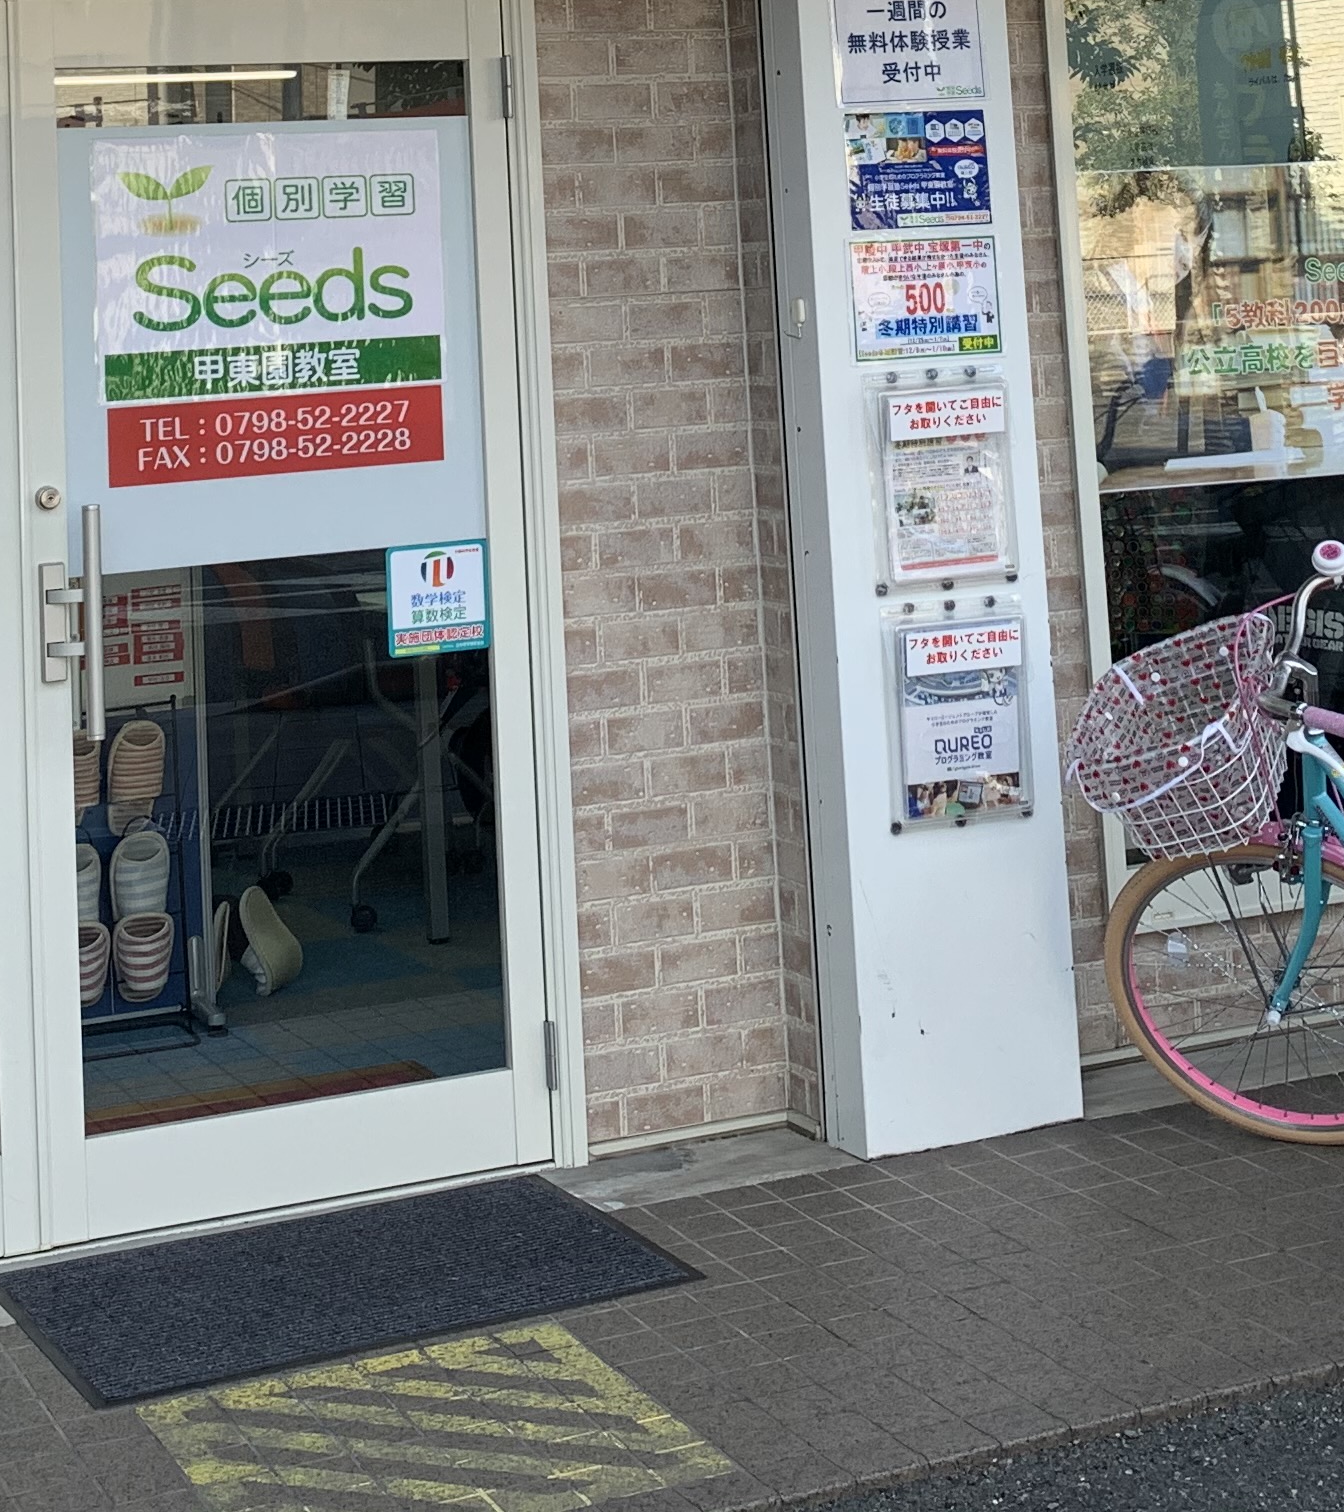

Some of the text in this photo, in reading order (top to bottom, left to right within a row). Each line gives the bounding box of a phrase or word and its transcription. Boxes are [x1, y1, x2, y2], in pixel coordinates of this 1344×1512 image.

[866, 0, 947, 23] 一週間の
[847, 28, 971, 55] 無料体験授業
[882, 61, 942, 85] 受付中
[231, 178, 408, 216] 個別学習
[243, 249, 295, 269] シーズ
[132, 246, 413, 332] Seeds
[905, 281, 947, 316] 500
[877, 313, 979, 337] 冬期特別講習
[962, 336, 995, 351] 受付中
[194, 347, 361, 388] 甲東園教室
[892, 395, 1002, 416] フタを開いてご自由に
[214, 400, 410, 436] 0798-52-2227
[909, 413, 987, 430] お取りください
[215, 428, 412, 466] 0798-52-2228
[410, 589, 467, 608] 数学検定
[411, 604, 468, 625] 算数検定
[395, 624, 485, 646] 実施団体認定校
[908, 629, 1019, 651] フタを開いてご自由に
[926, 647, 1003, 665] お取りください
[934, 733, 993, 755] QUREO
